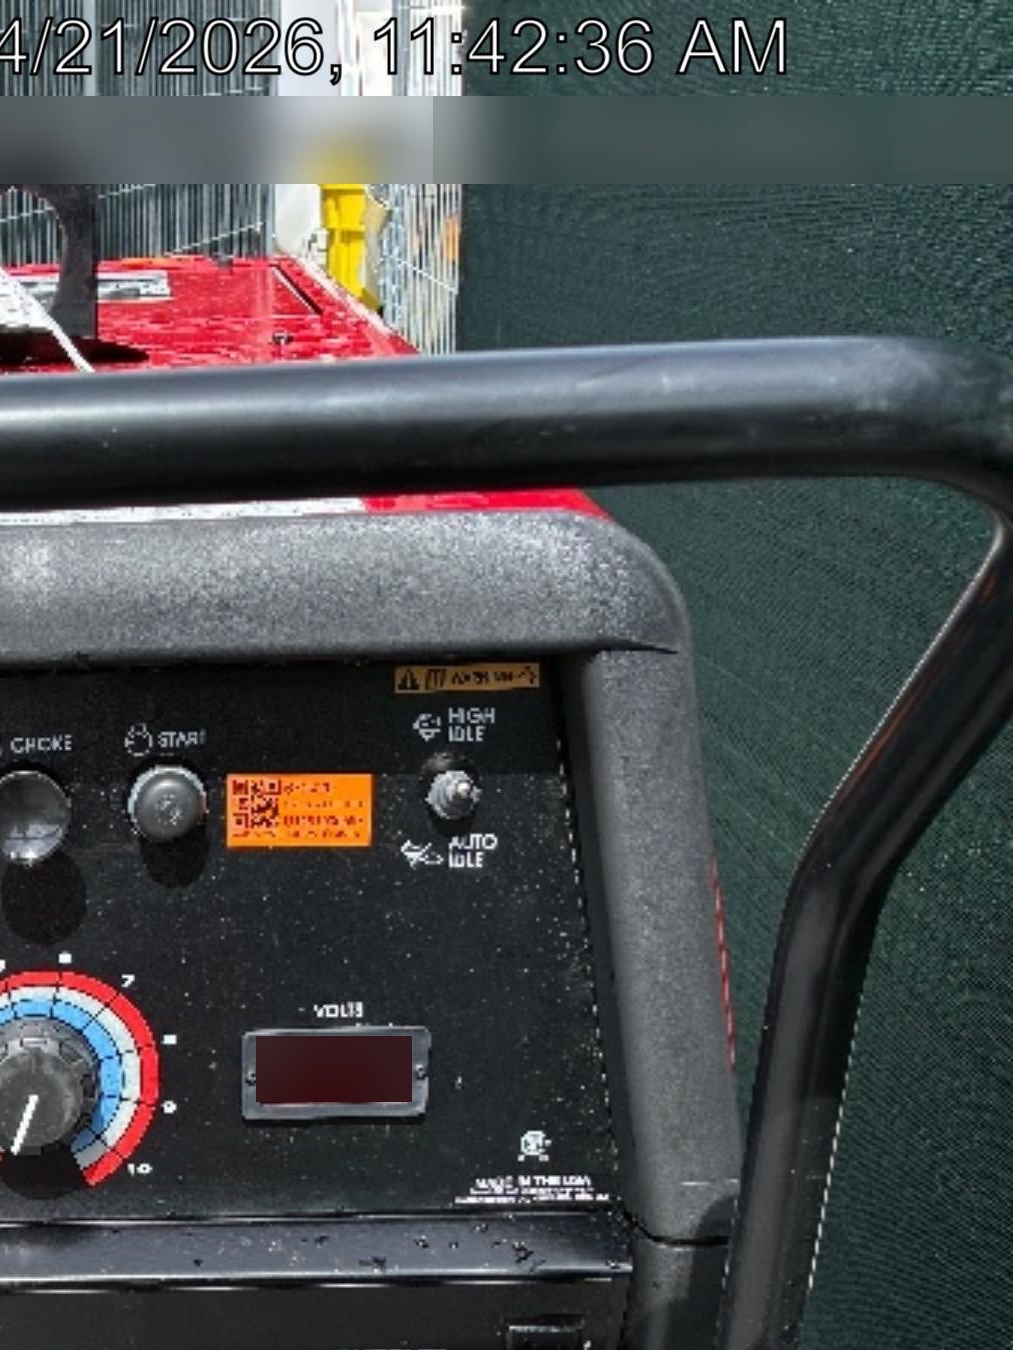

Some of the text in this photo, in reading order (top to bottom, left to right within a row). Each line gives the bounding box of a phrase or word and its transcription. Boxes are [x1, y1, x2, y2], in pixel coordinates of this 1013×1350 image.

[448, 707, 496, 724] HIGH
[157, 728, 207, 749] START
[448, 725, 486, 742] IDLE
[9, 734, 73, 754] CHOKE
[448, 832, 499, 850] AUTO
[448, 851, 485, 869] IDLE
[120, 974, 136, 988] 7
[128, 1163, 153, 1176] 10
